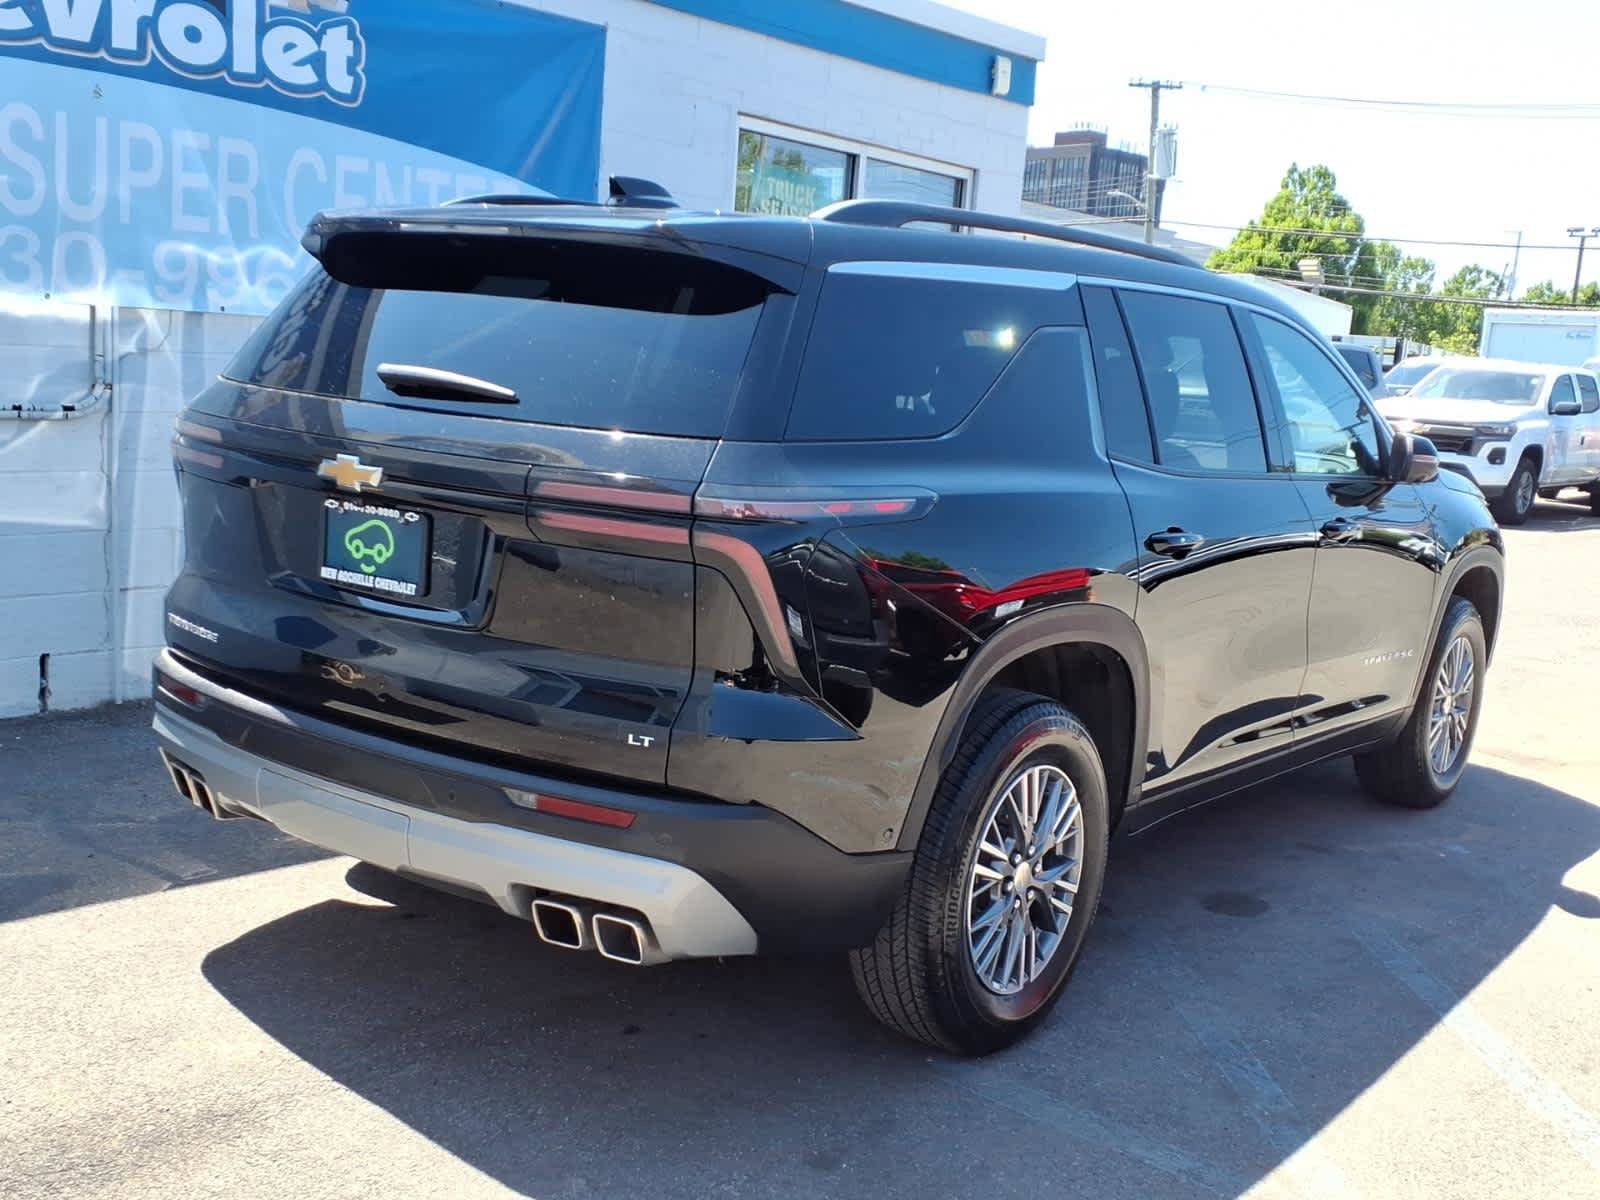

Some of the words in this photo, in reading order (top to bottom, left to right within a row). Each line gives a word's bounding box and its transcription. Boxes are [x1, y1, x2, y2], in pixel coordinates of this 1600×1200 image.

[0, 104, 261, 239] SUPER
[767, 176, 817, 211] TRUCK
[374, 576, 417, 596] CHEVROLET
[628, 733, 655, 748] LT
